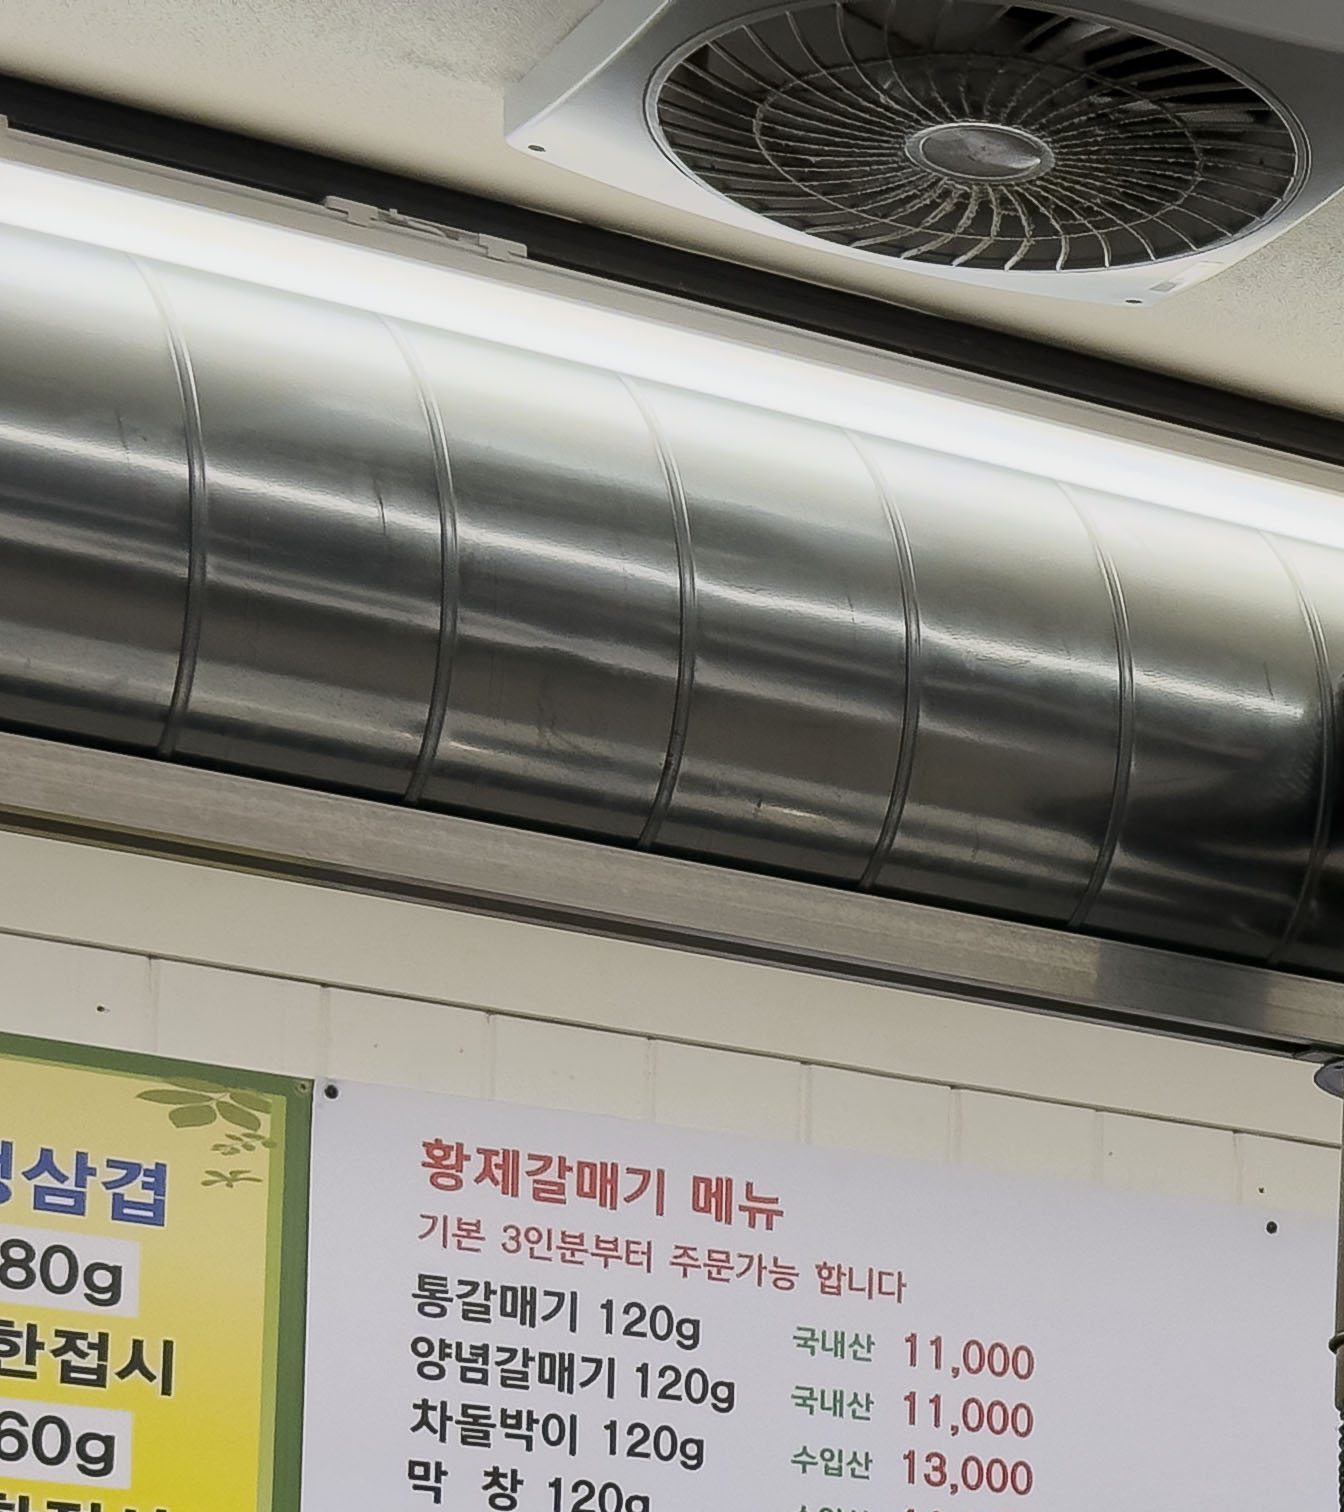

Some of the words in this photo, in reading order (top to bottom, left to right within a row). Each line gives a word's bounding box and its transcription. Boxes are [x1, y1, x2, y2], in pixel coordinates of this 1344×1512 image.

[421, 1138, 665, 1216] 황제갈매기
[692, 1175, 784, 1231] 메뉴
[418, 1214, 486, 1253] 기본
[501, 1224, 652, 1273] 3인분부터
[669, 1245, 800, 1291] 주문가능
[815, 1261, 907, 1304] 합니다
[411, 1273, 577, 1333] 통갈매기
[600, 1299, 700, 1351] 120g
[793, 1327, 875, 1362] 국내산
[905, 1333, 1034, 1380] 11,000
[411, 1336, 615, 1399] 양념갈매기
[635, 1362, 735, 1413] 120g
[791, 1386, 874, 1421] 국내산
[904, 1391, 1033, 1438] 11,000
[410, 1398, 577, 1456] 차돌박이
[604, 1420, 704, 1470] 120g
[791, 1446, 873, 1480] 수입산
[903, 1449, 1033, 1496] 13,000
